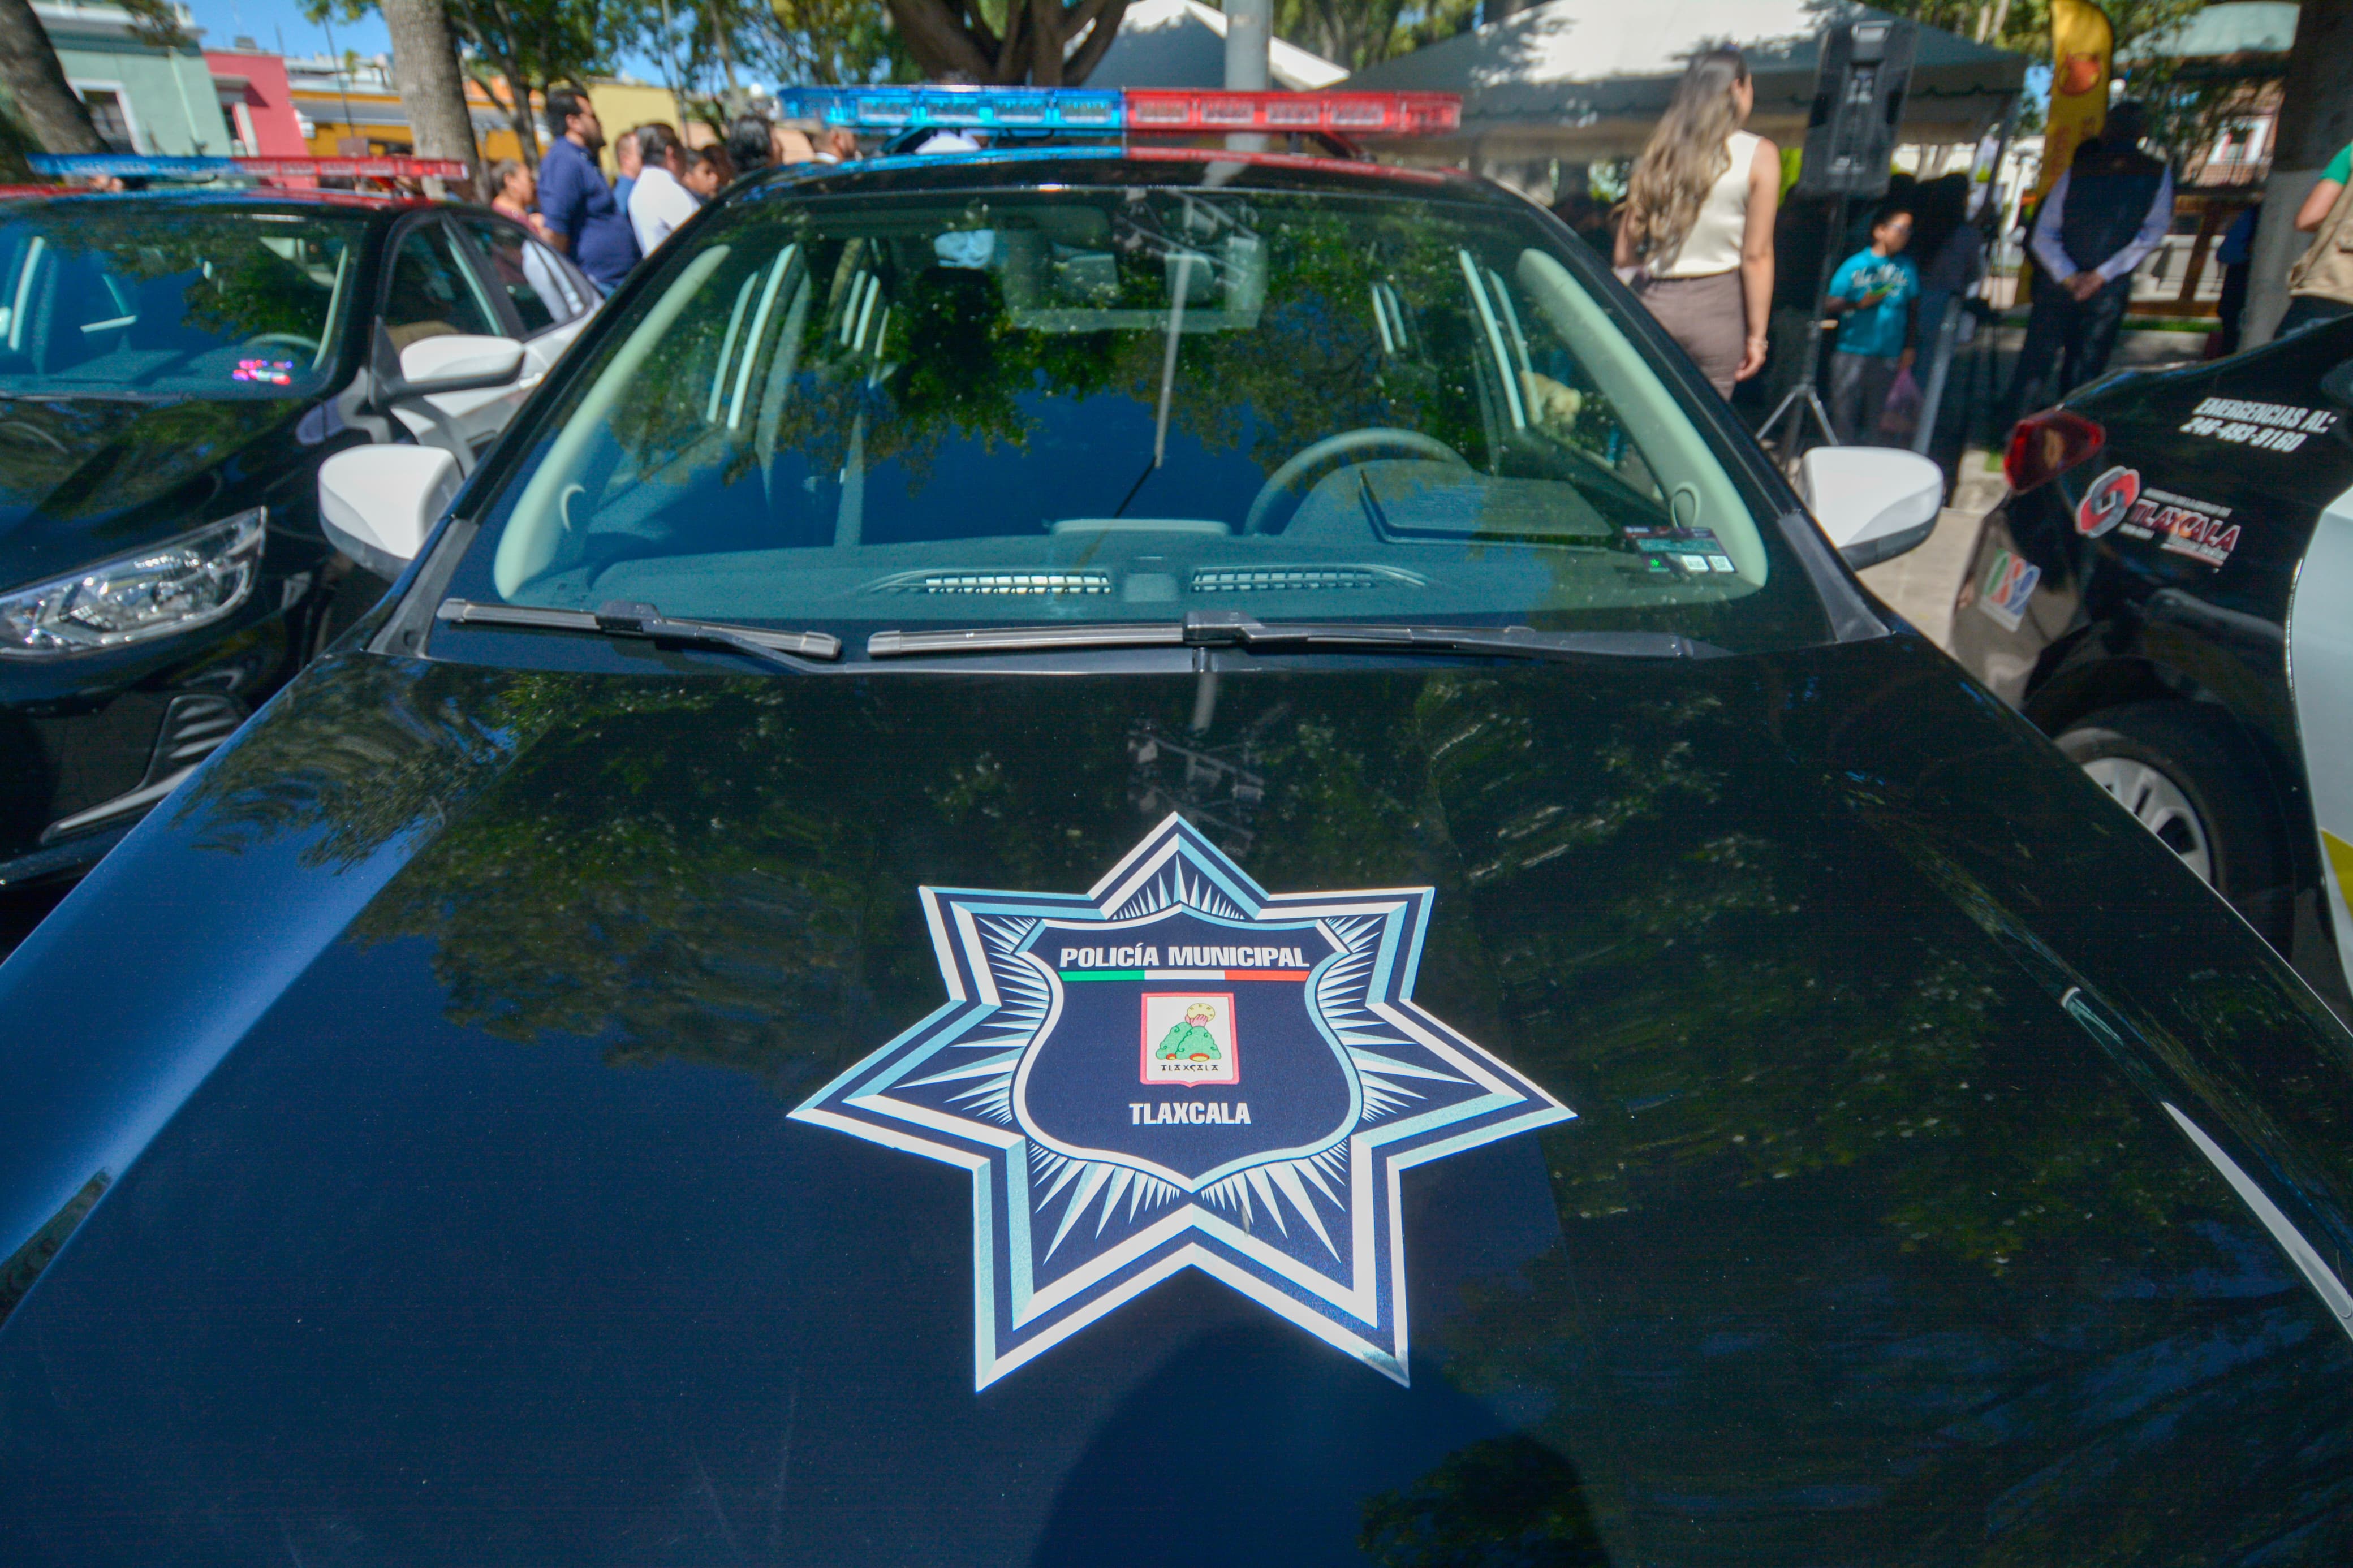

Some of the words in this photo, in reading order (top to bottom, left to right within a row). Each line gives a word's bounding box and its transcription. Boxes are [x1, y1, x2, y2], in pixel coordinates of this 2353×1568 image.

[2192, 396, 2309, 429] EMERGENCIAS
[2298, 409, 2338, 434] AL:
[2129, 498, 2242, 552] TLAXCALA
[1059, 942, 1160, 968] POLICÍA
[1168, 946, 1311, 967] MUNICIPAL
[1128, 1102, 1252, 1125] TLAXCALA
